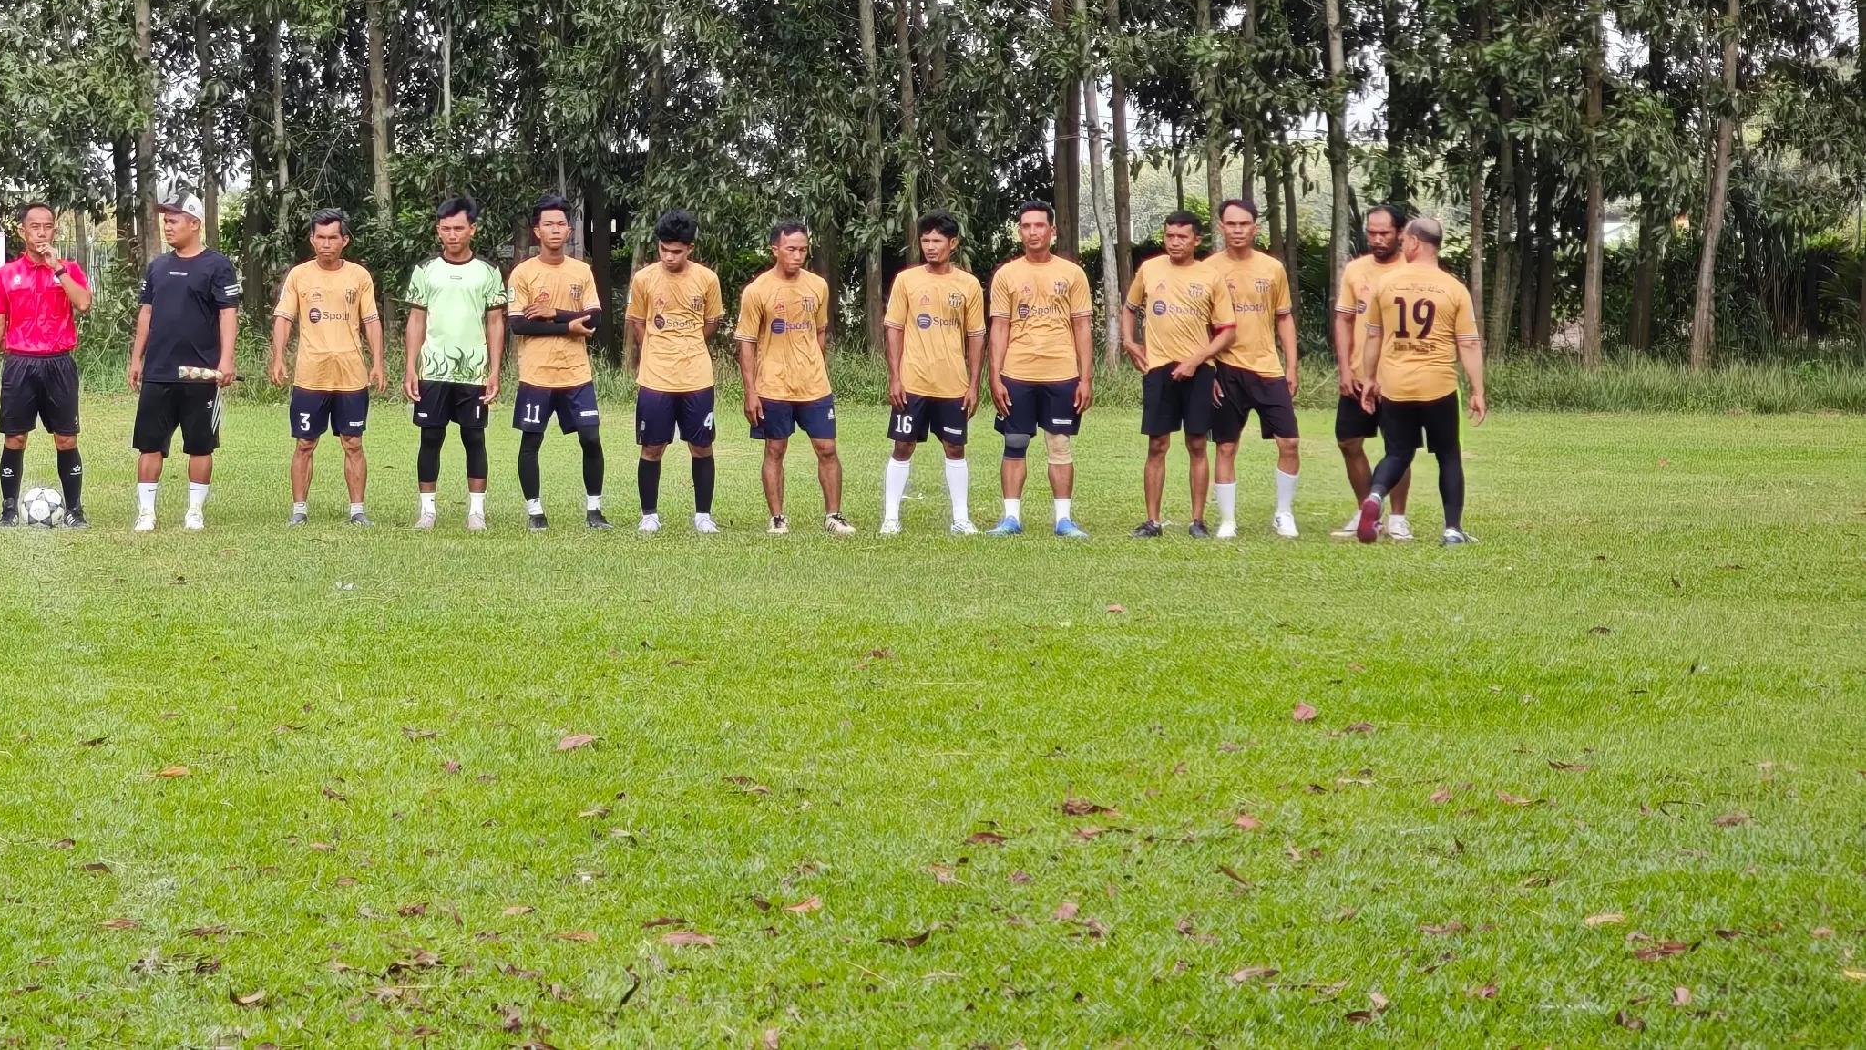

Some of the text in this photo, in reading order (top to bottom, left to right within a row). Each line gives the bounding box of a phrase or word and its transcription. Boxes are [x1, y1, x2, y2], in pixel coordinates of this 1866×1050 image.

[1393, 296, 1436, 339] 19
[299, 412, 311, 431] 3
[476, 405, 480, 419] 1
[523, 403, 541, 423] 11
[703, 411, 714, 431] 4
[895, 414, 913, 434] 16
